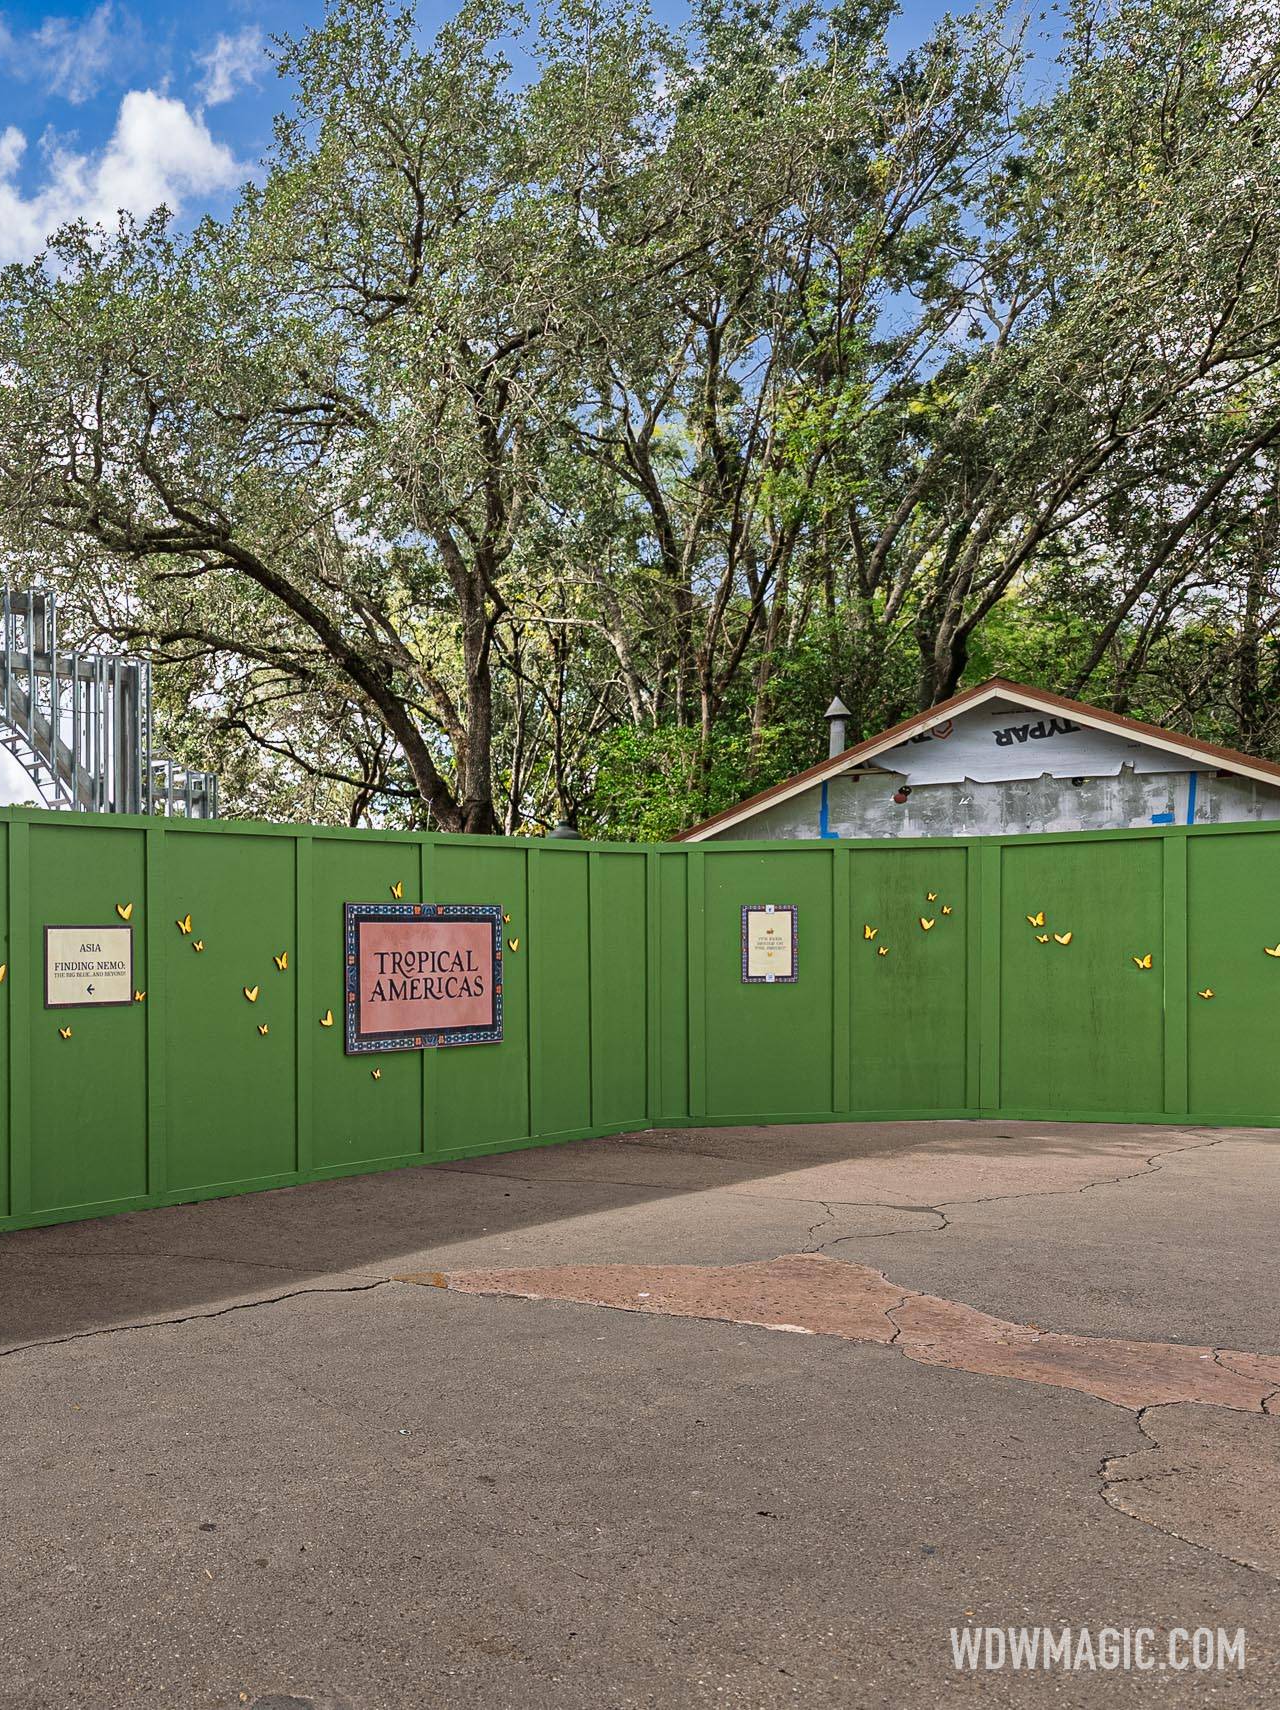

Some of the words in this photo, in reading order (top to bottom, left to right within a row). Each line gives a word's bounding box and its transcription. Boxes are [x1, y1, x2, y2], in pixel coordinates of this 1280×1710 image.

[992, 717, 1082, 747] TYPAR
[80, 943, 102, 953] ASIA
[54, 961, 95, 971] FINDING
[97, 961, 126, 971] NEMO:
[374, 950, 479, 979] TROPICAL
[368, 975, 485, 1002] AMERICAS
